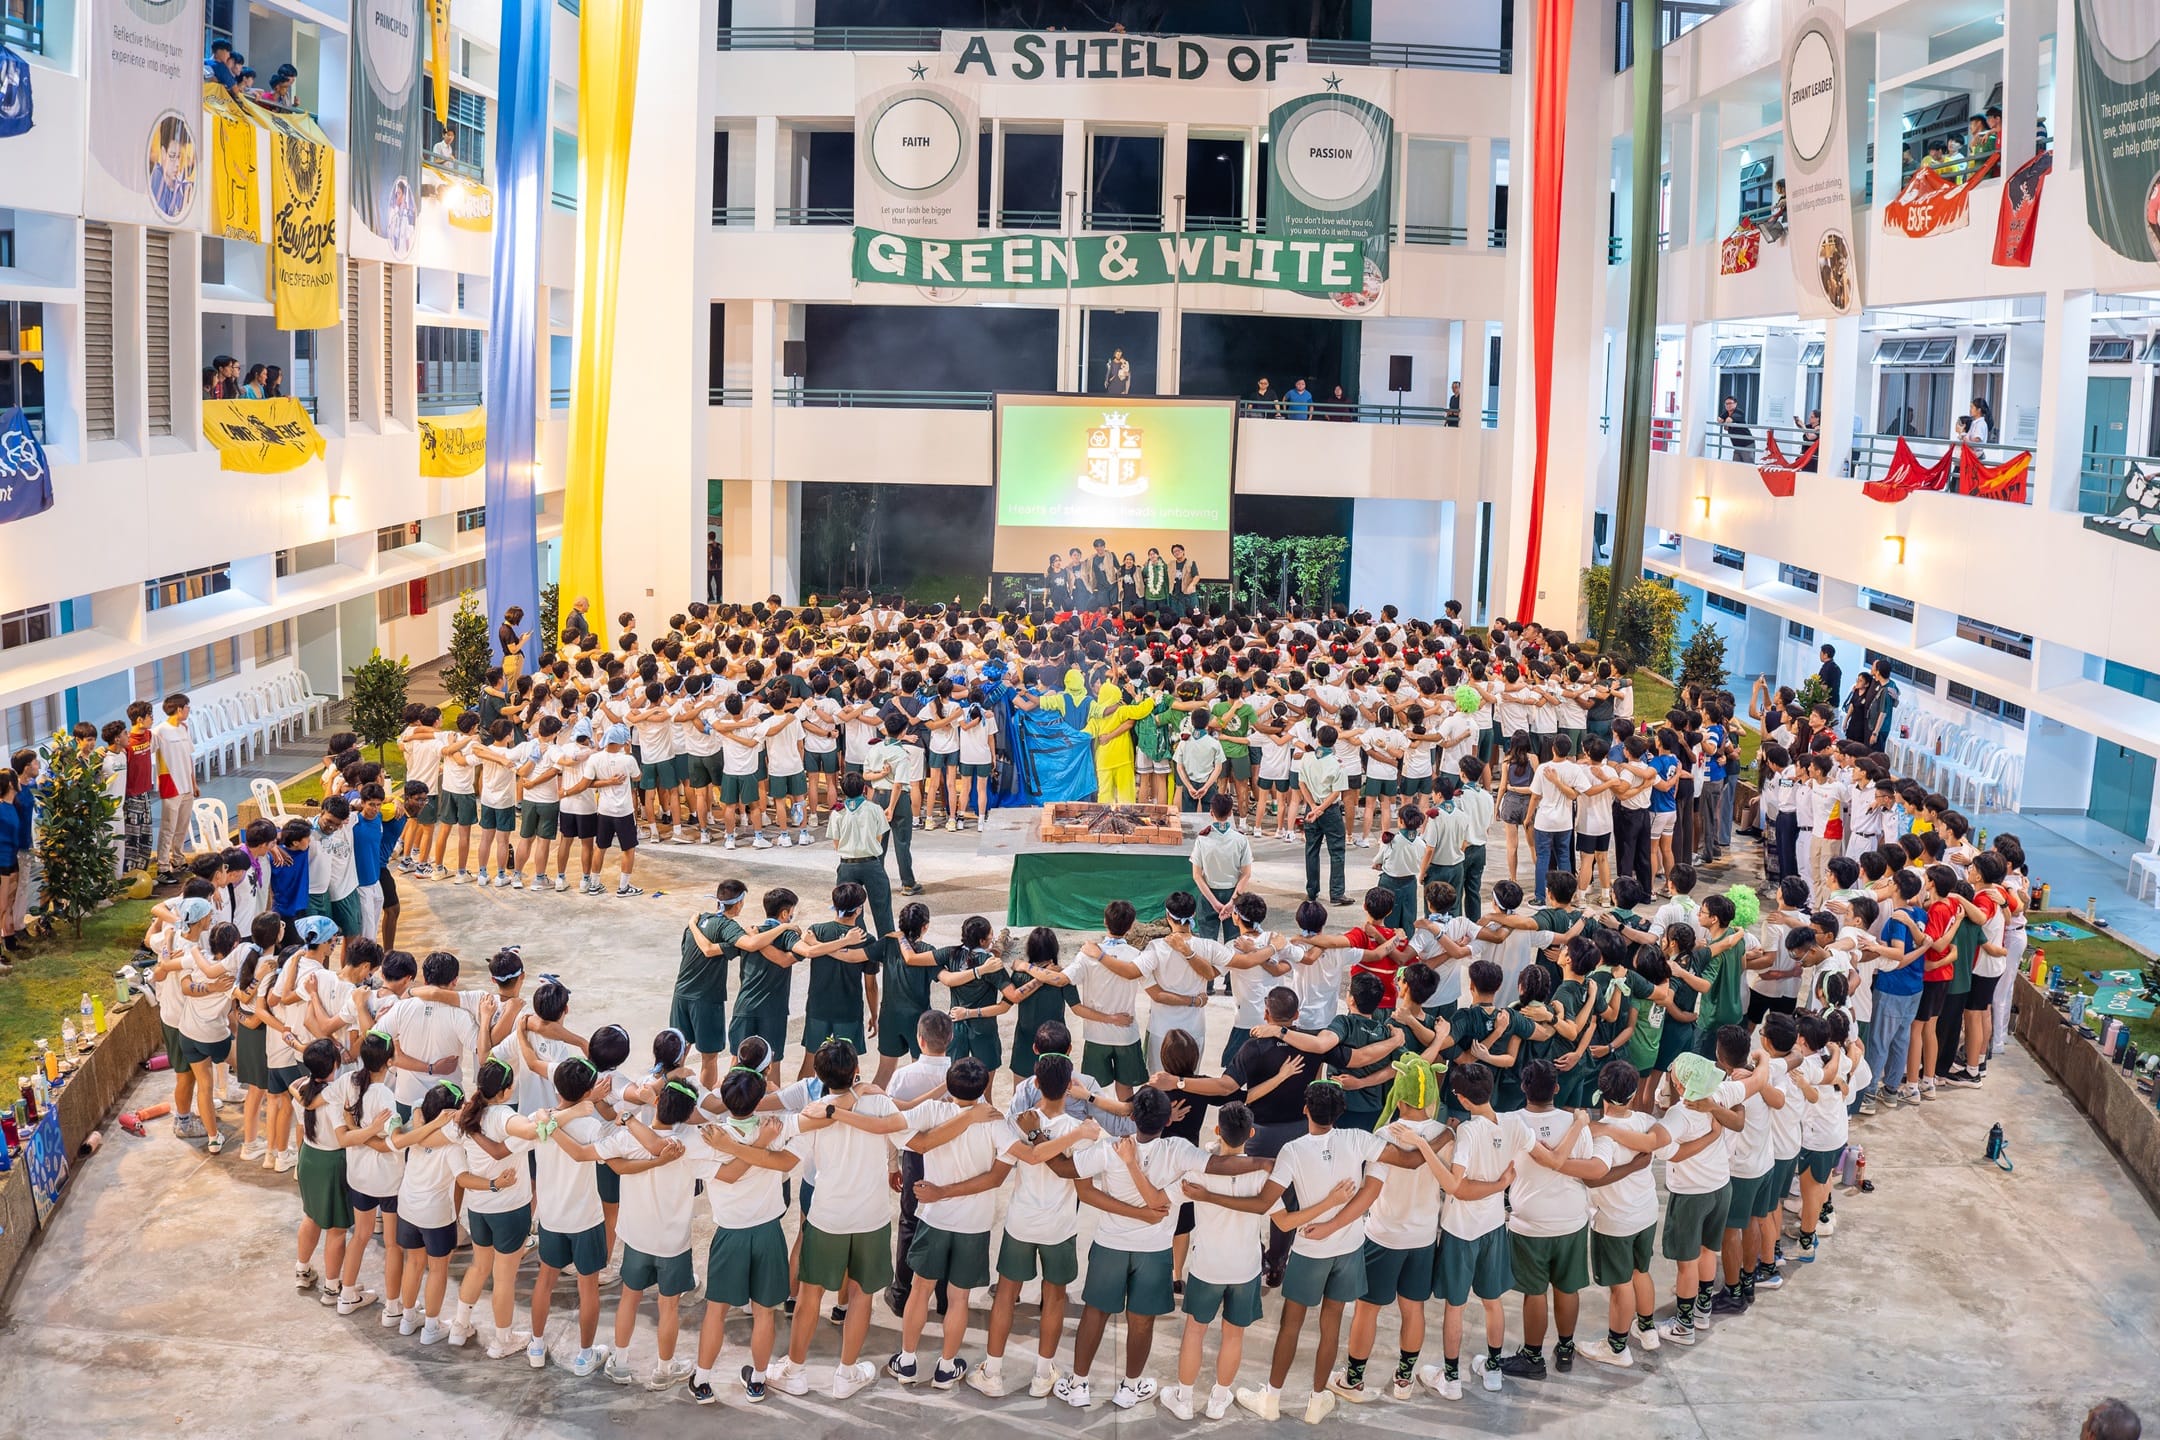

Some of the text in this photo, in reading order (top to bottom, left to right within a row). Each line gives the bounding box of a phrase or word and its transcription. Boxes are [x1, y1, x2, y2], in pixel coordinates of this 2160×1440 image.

[113, 25, 143, 46] Reflective
[144, 33, 168, 57] thinking
[111, 49, 145, 68] experience
[147, 58, 159, 72] into
[954, 34, 1295, 82] A SHIELD OF
[1811, 77, 1833, 96] LEADER
[2101, 90, 2160, 119] The purpose of life
[2118, 120, 2137, 136] show
[902, 137, 930, 147] FAITH
[2112, 141, 2125, 159] and
[2125, 139, 2141, 158] help
[1310, 147, 1353, 159] PASSION
[881, 206, 952, 216] Let your faith be bigger
[907, 218, 921, 226] your
[1285, 215, 1374, 228] If you don't love what you do,
[1331, 228, 1336, 236] it
[1336, 228, 1350, 236] with
[1351, 229, 1368, 237] much
[867, 234, 1355, 286] GREEN & WHITE
[1007, 504, 1046, 516] Hearts
[1050, 504, 1062, 515] of
